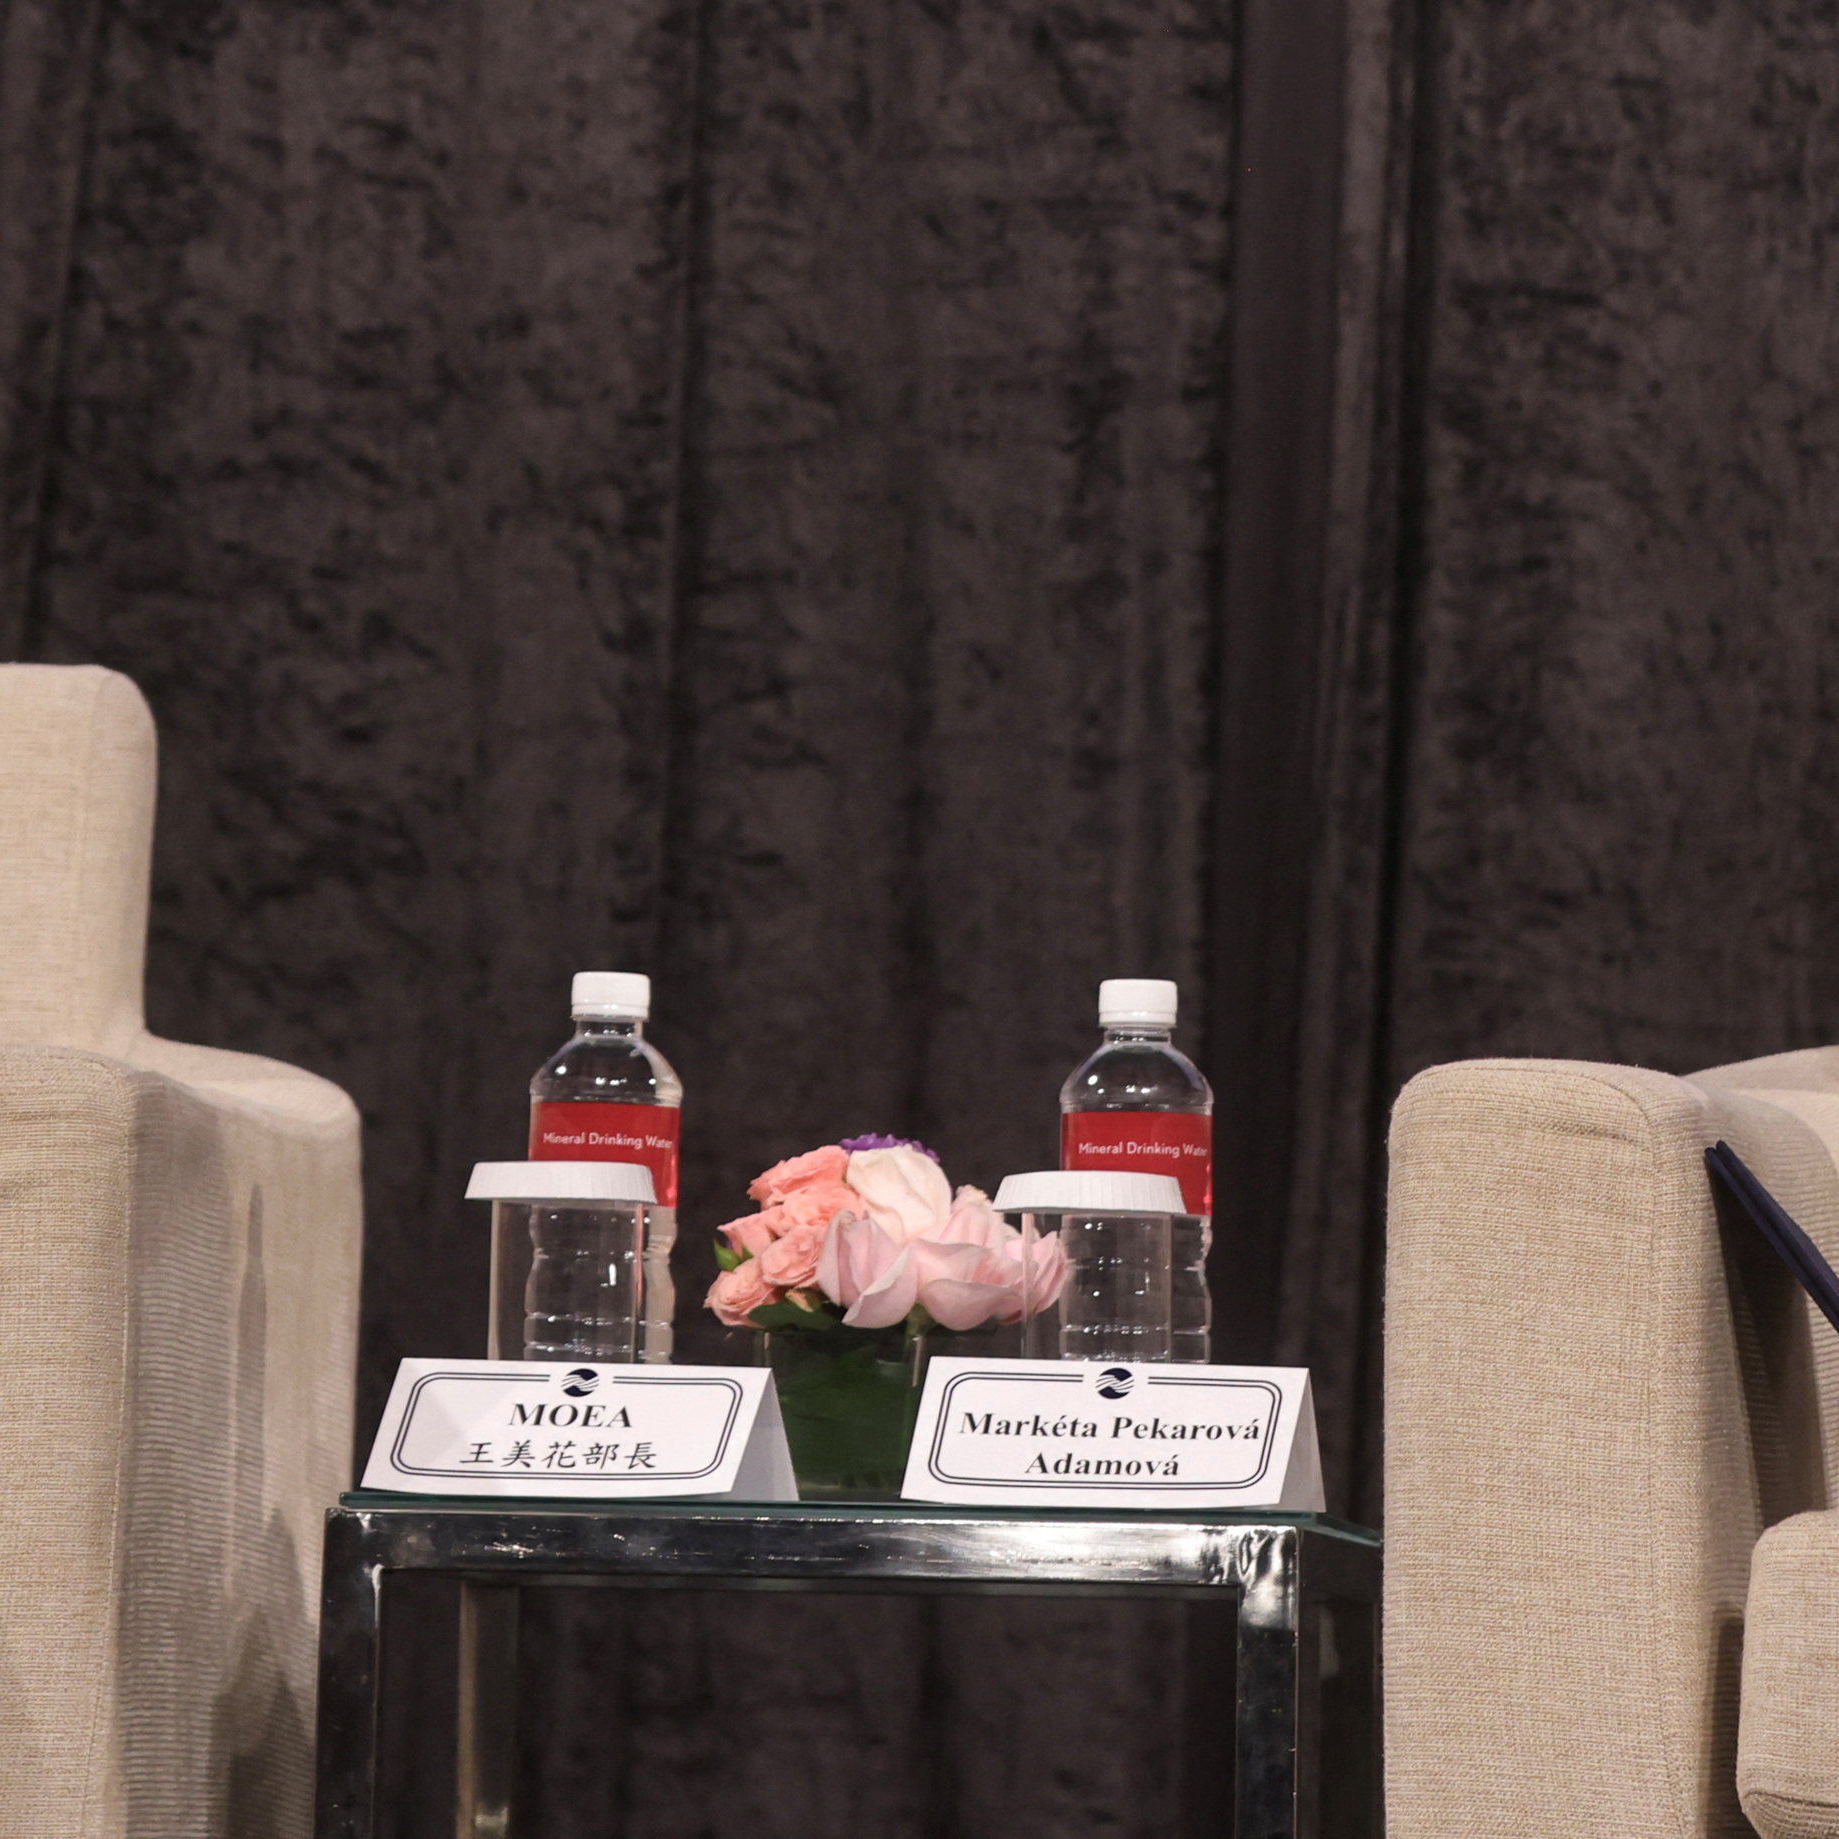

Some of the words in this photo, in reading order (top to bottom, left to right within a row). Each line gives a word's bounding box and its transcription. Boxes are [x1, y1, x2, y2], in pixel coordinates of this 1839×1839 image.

[543, 1132, 586, 1145] Mineral
[589, 1132, 644, 1150] Drinking
[1078, 1142, 1124, 1155] Mineral
[1127, 1142, 1181, 1159] Drinking
[509, 1403, 633, 1429] MOEA
[960, 1411, 1099, 1439] Markéta
[1110, 1416, 1261, 1441] Pekarová
[459, 1439, 658, 1471] 王美花部長
[1025, 1452, 1181, 1477] Adamová
